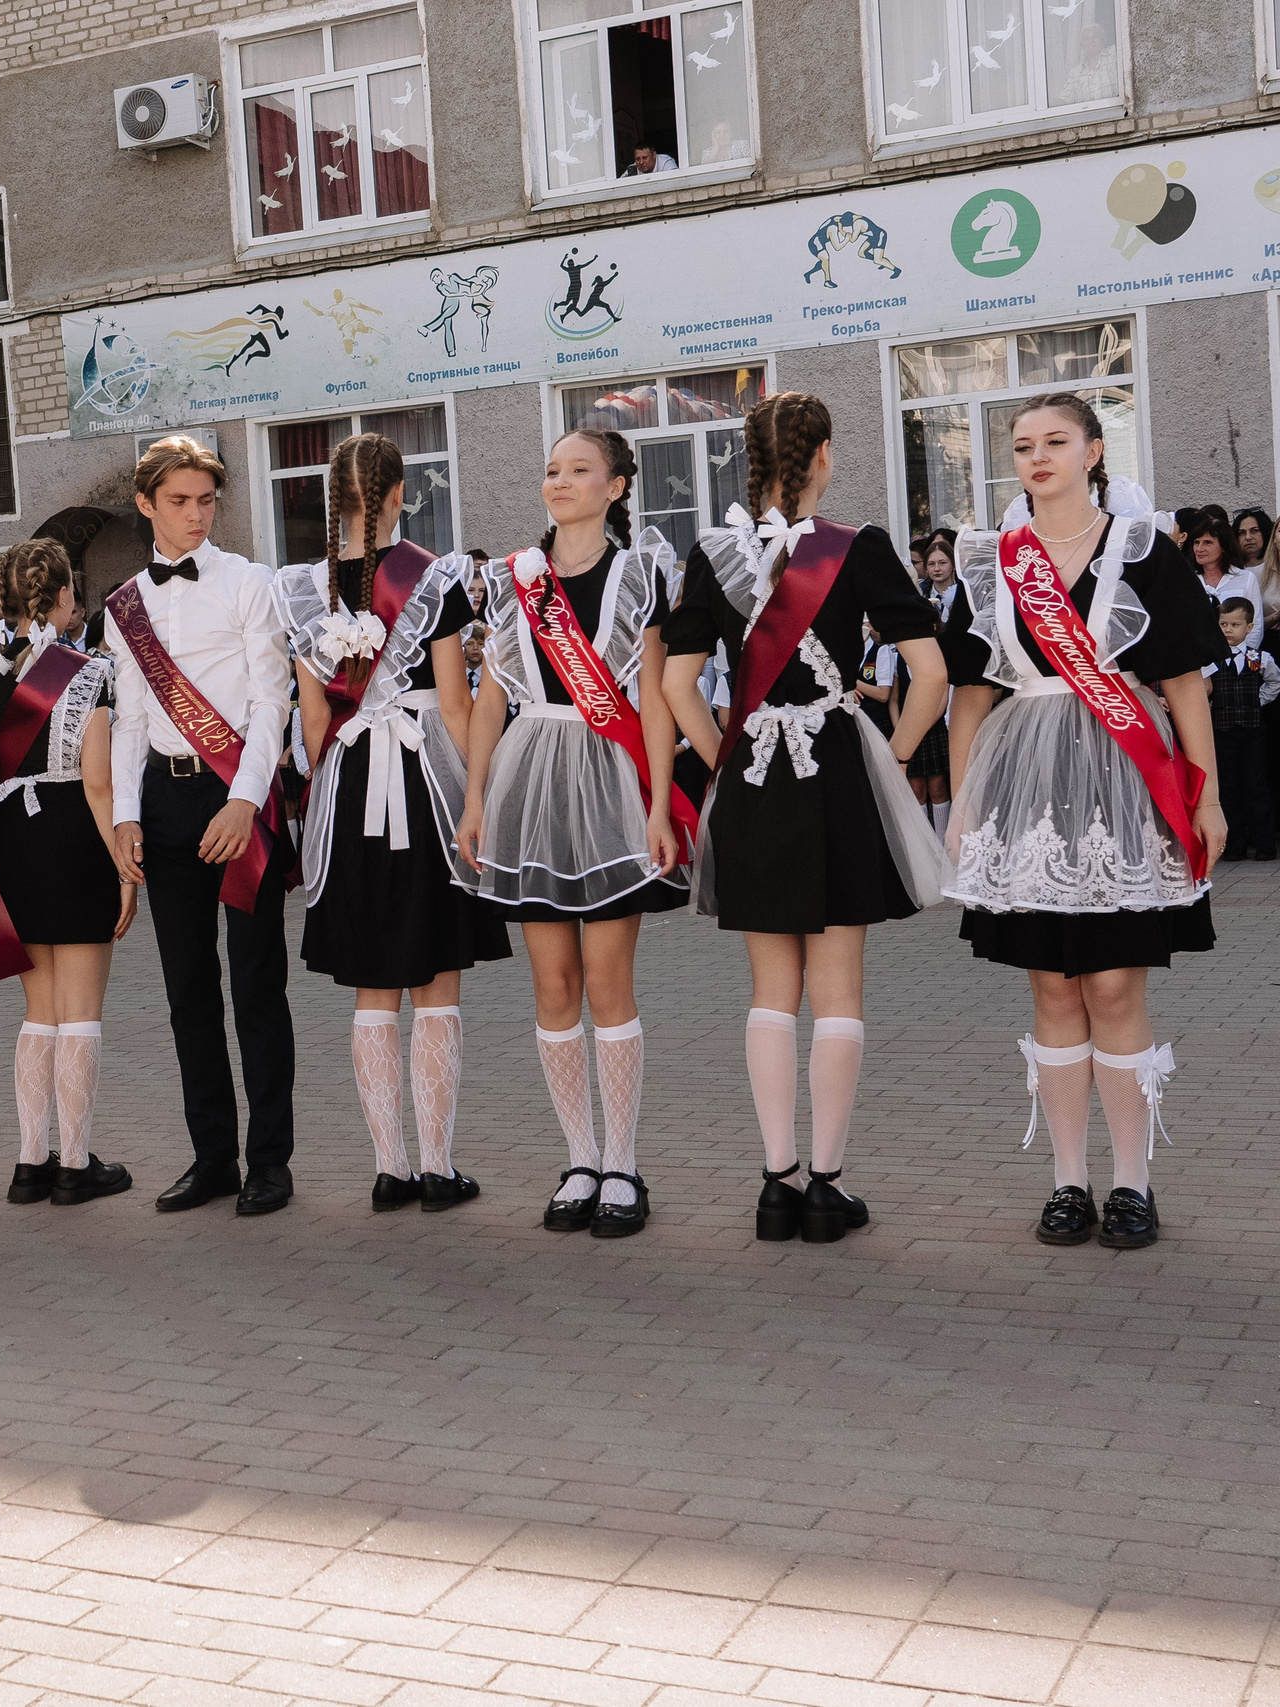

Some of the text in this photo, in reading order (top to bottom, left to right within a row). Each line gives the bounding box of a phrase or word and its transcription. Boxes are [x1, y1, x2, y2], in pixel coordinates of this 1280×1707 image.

[1077, 268, 1234, 297] Настольный теннис
[802, 296, 907, 320] Греко-римская
[965, 294, 1036, 312] Шахматы
[662, 313, 773, 338] Художественная
[831, 320, 881, 337] борьба
[556, 348, 619, 364] Волейбол
[680, 337, 758, 355] гимнастика
[407, 361, 520, 384] Спортивные танцы
[325, 380, 367, 396] Футбол
[189, 391, 279, 411] Легкая атлетика
[88, 414, 150, 432] Планета 40
[1019, 582, 1145, 731] Выпускница 2025
[129, 615, 238, 754] Выпускник 2025
[585, 691, 622, 728] 2025
